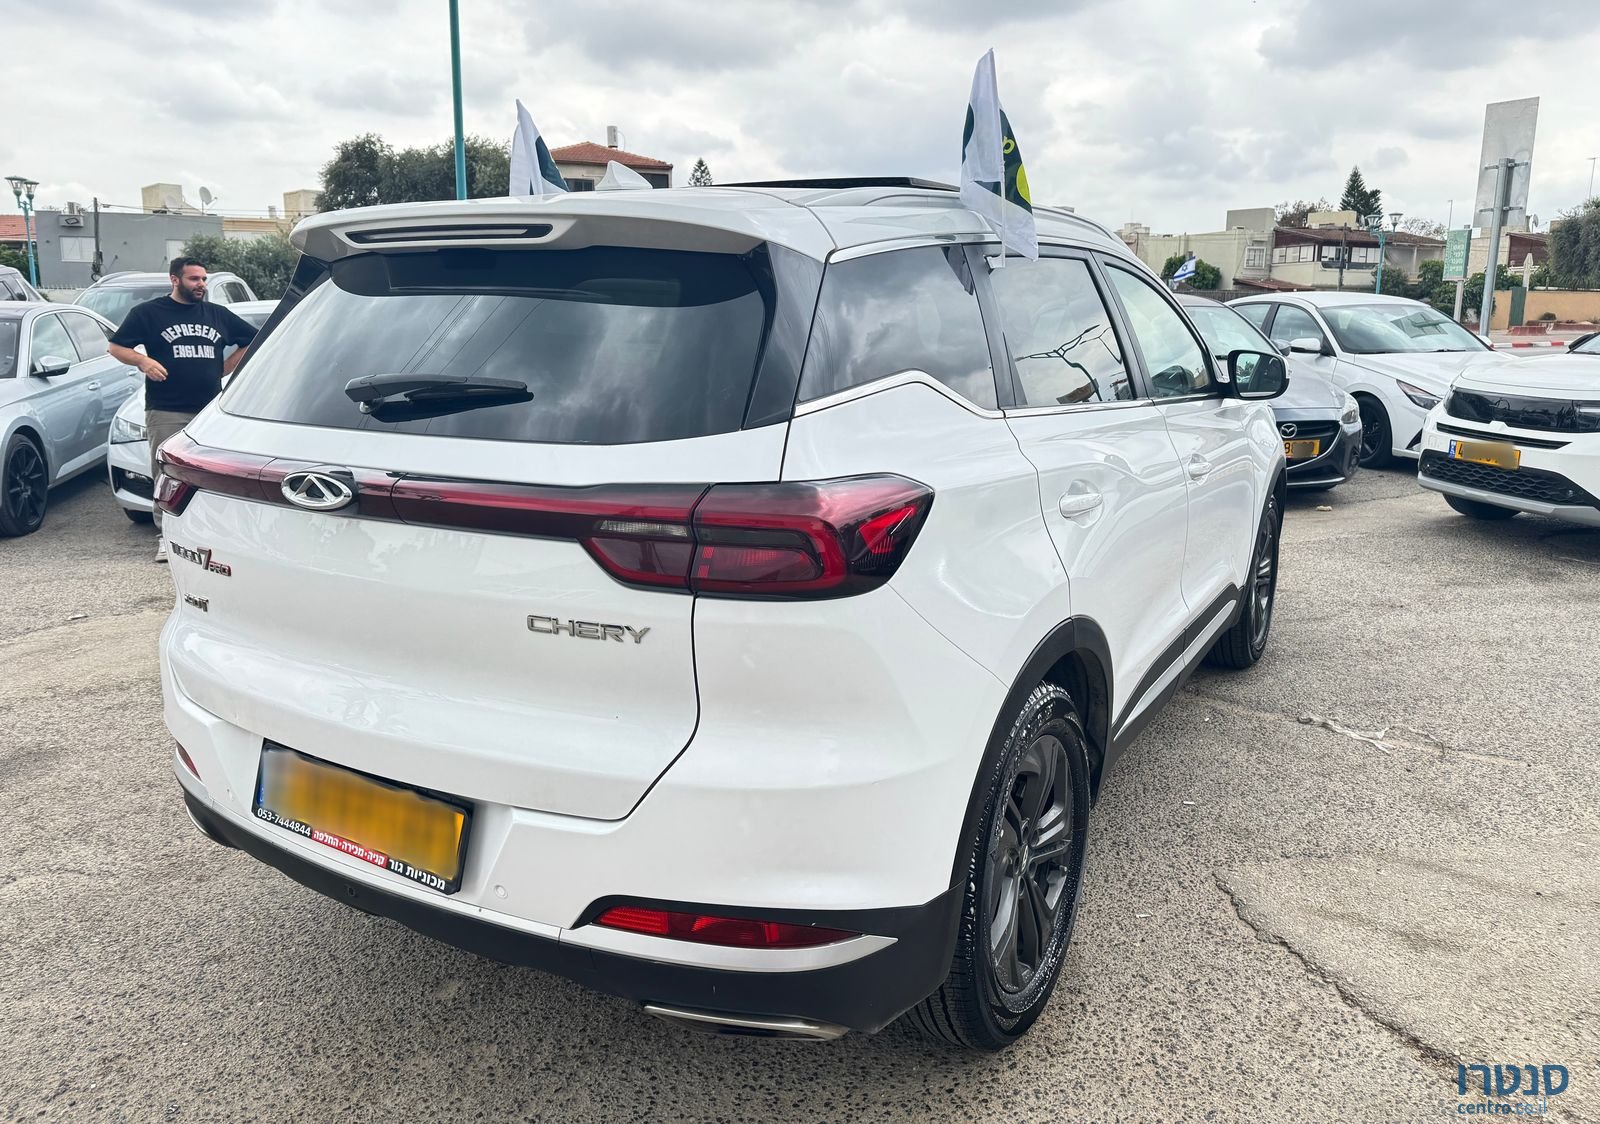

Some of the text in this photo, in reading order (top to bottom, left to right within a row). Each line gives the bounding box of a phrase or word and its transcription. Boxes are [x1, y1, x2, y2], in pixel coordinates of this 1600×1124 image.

[160, 323, 222, 344] REPRESENT
[173, 344, 215, 359] ENGLAND
[526, 614, 652, 644] CHERY
[256, 807, 312, 837] 053-7444844
[388, 858, 405, 874] גור
[405, 865, 446, 891] מכוניות
